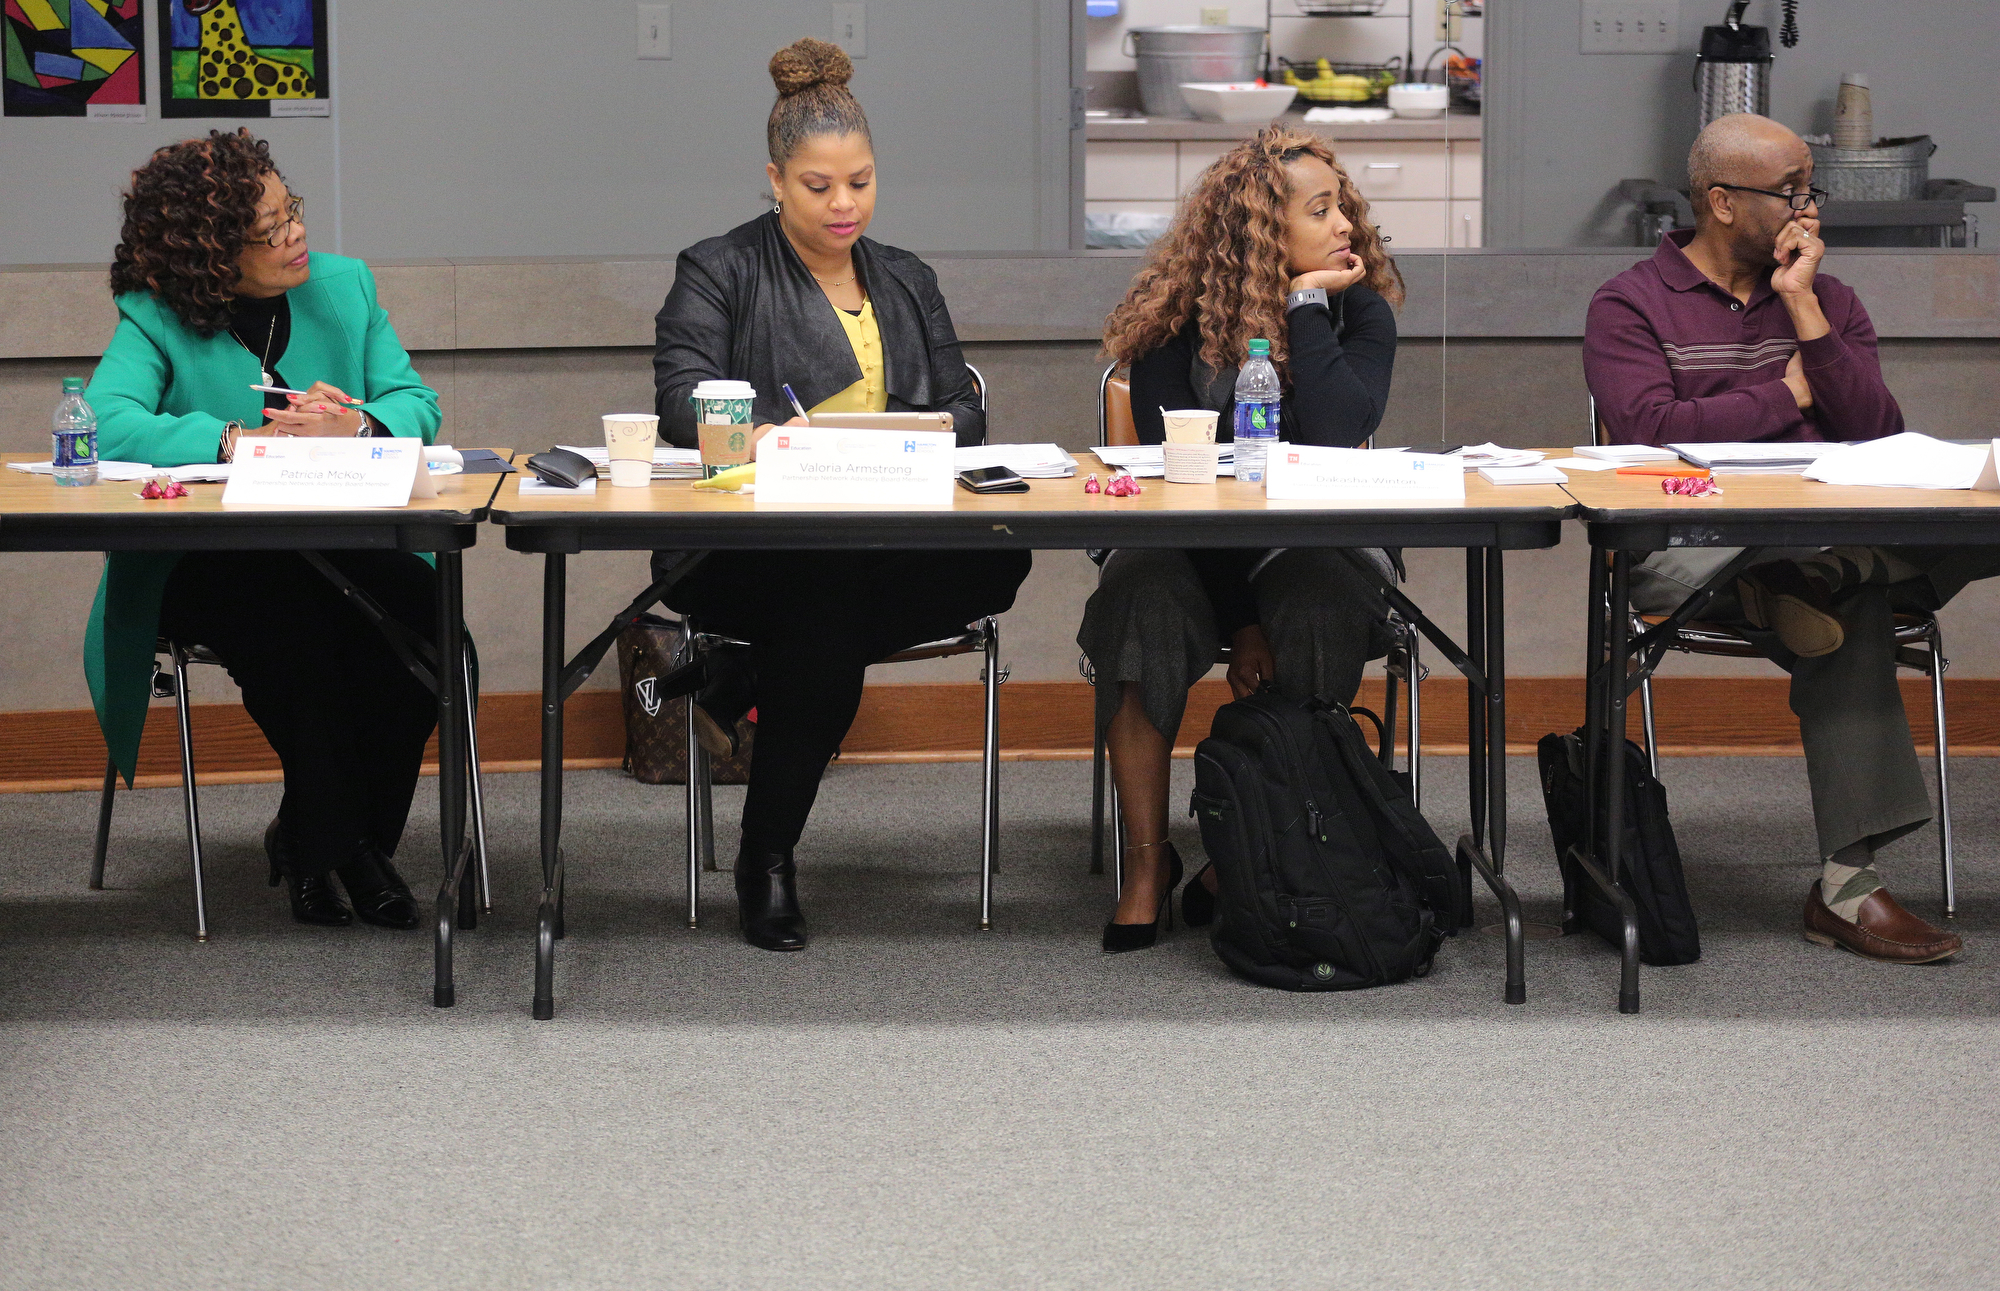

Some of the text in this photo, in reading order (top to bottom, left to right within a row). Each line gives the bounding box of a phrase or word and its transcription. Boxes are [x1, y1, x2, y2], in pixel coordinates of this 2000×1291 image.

[280, 469, 367, 481] Patricia McKoy
[799, 462, 912, 476] Valoria Armstrong
[1315, 475, 1417, 485] Dakasha Winton
